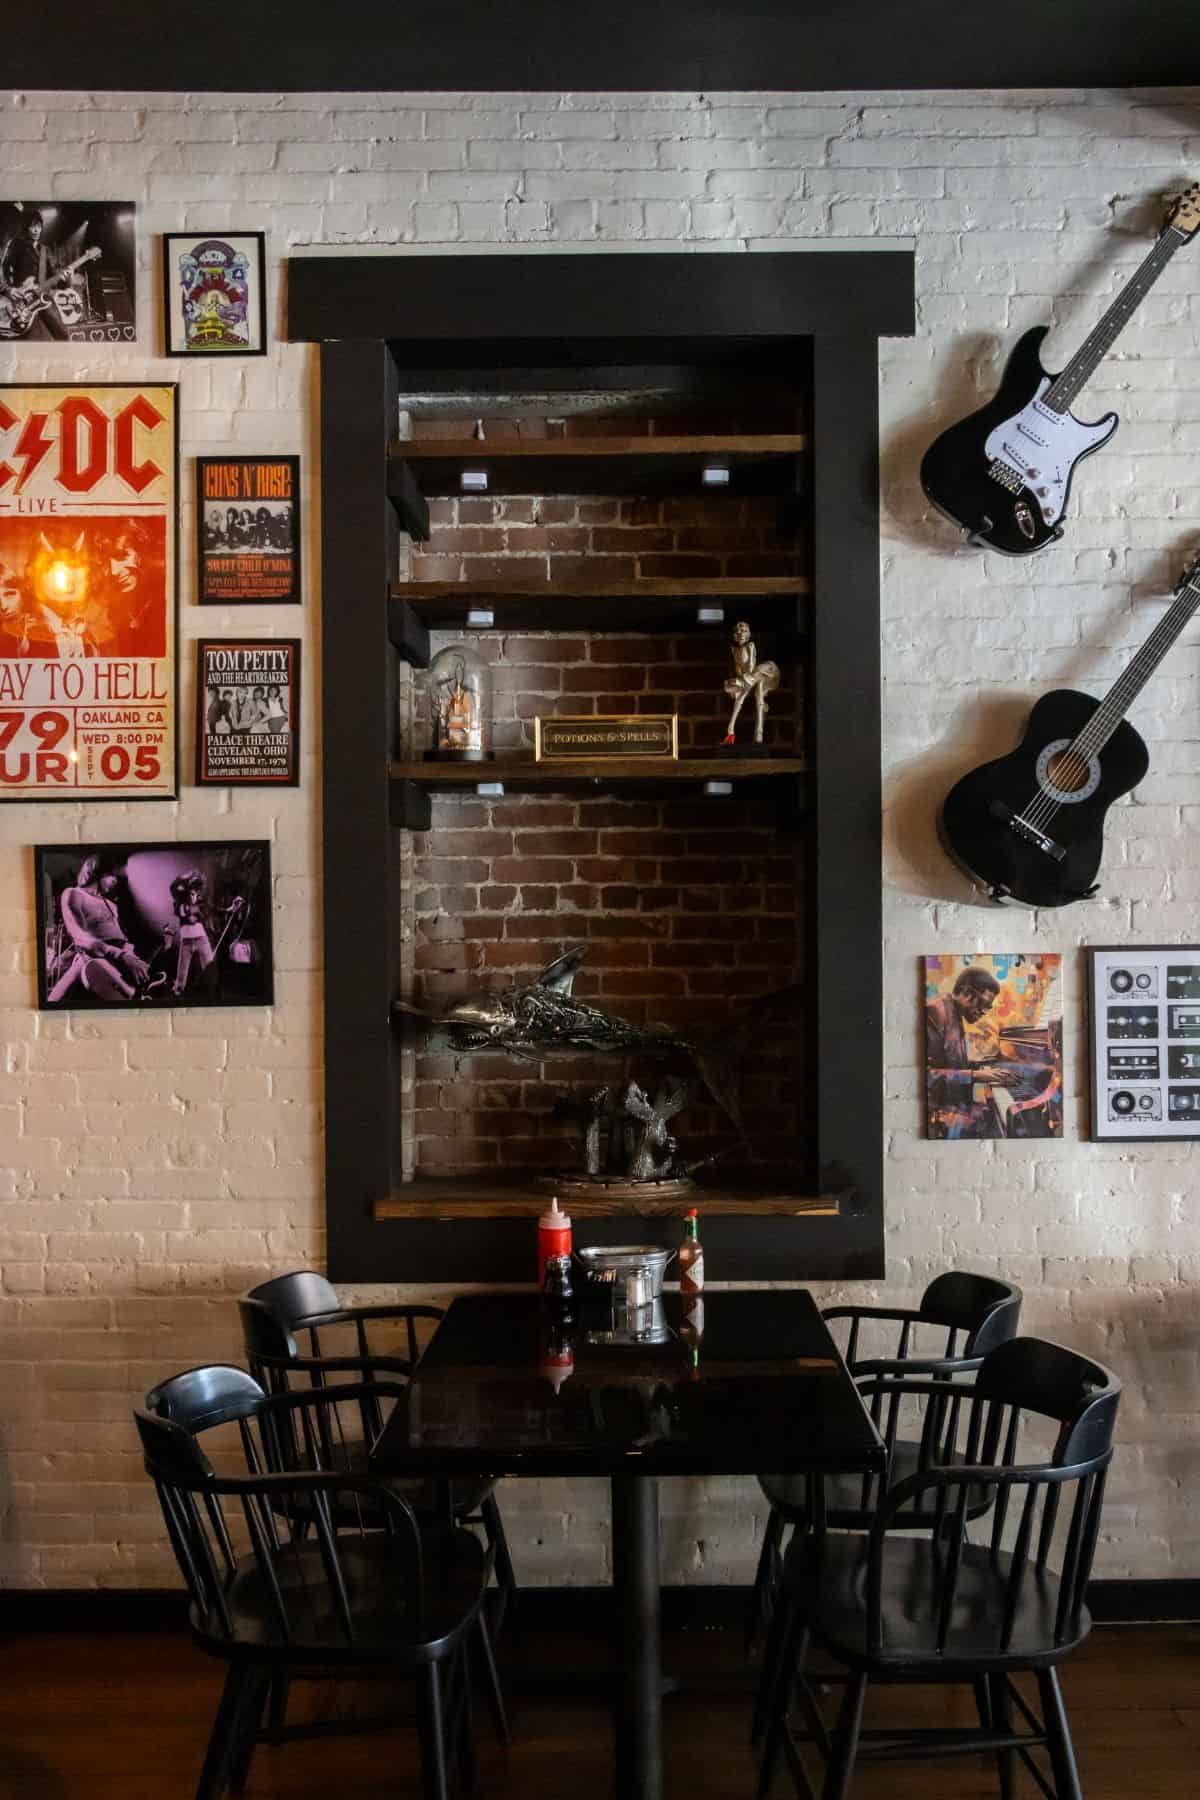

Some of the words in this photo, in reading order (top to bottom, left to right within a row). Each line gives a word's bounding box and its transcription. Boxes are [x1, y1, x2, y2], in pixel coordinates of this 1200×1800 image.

[206, 464, 239, 497] GUNS
[18, 498, 57, 512] LIVE
[206, 650, 239, 671] TOM
[243, 650, 289, 671] PETTY
[0, 663, 33, 701] AY
[43, 663, 84, 700] TO
[94, 662, 168, 700] HELL
[208, 672, 221, 684] AND
[82, 712, 141, 723] OAKLAND
[147, 712, 164, 723] CA
[82, 734, 110, 744] WED
[116, 734, 142, 744] 8:00
[146, 734, 164, 744] PM
[207, 735, 243, 746] PALACE
[244, 734, 289, 746] THEATRE
[553, 733, 603, 744] POTIONS
[607, 732, 617, 743] &
[619, 732, 658, 742] SPELLS
[207, 746, 262, 757] CLEVELAND,
[263, 746, 287, 756] OHIO
[100, 745, 161, 781] 05
[208, 756, 256, 766] NOVEMBER
